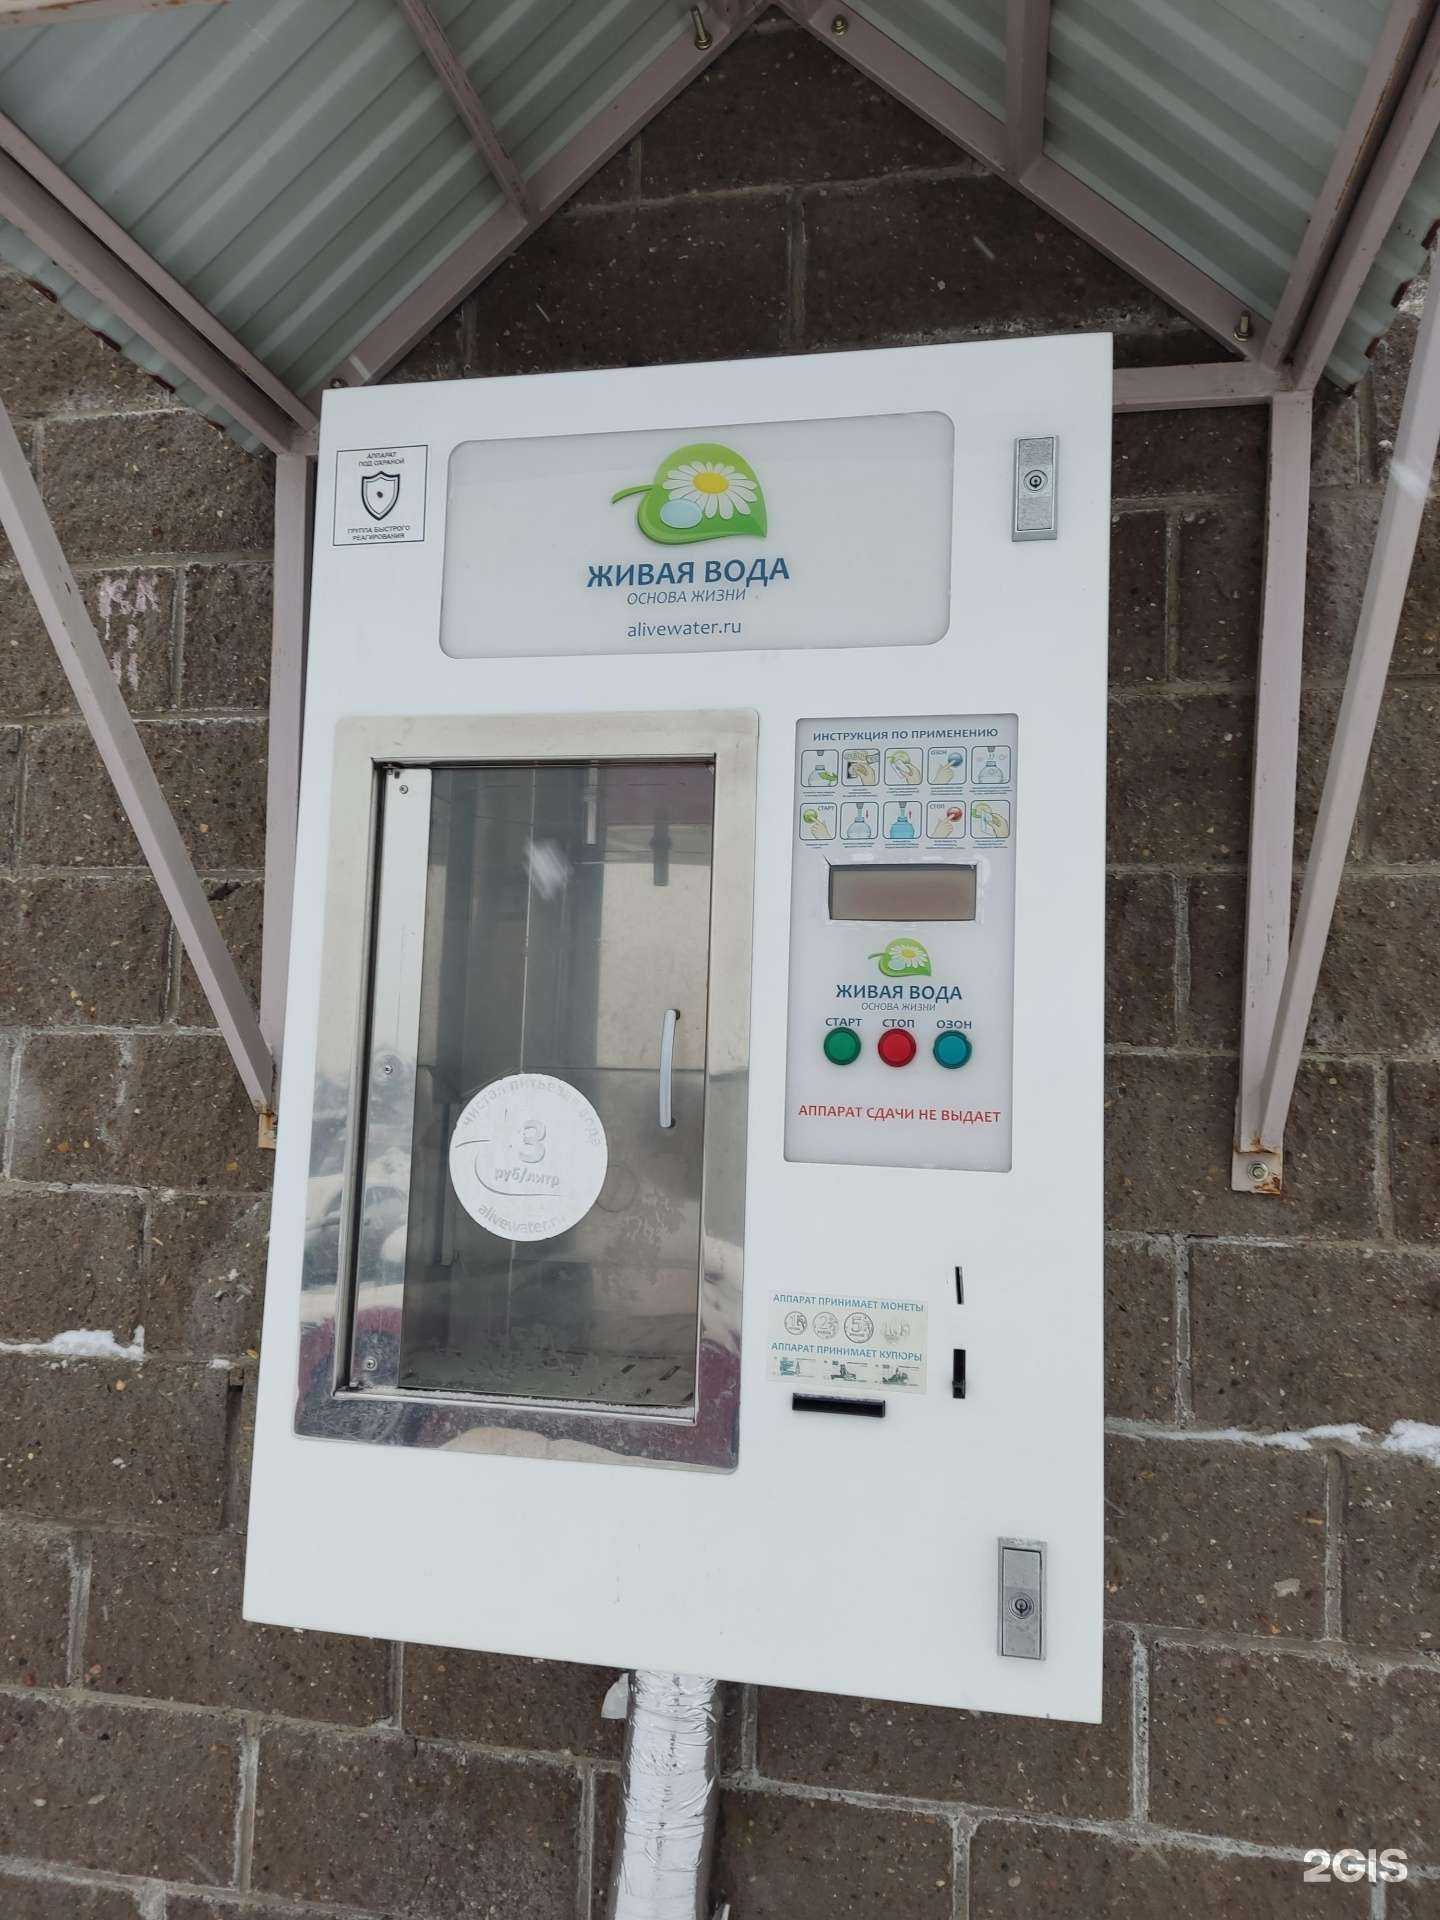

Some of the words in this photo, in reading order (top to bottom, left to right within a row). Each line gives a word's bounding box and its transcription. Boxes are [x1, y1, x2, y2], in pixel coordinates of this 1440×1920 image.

[358, 459, 373, 467] ПОД
[374, 525, 411, 533] БЫСТРОГО
[352, 533, 405, 541] РЕАГИРОВАНИЯ
[586, 560, 695, 588] ЖИВАЯ
[704, 557, 790, 587] ВОДА
[626, 591, 688, 606] ОСНОВА
[690, 588, 747, 602] ЖИЗНИ
[626, 621, 742, 638] alivewater.ru
[812, 731, 889, 742] ИНСТРУКЦИЯ
[891, 730, 909, 740] ПО
[911, 728, 998, 739] ПРИМЕНЕНИЮ
[836, 984, 903, 999] ЖИВАЯ
[909, 985, 963, 1003] ВОДА
[861, 1002, 899, 1011] ОСНОВА
[901, 1003, 936, 1012] ЖИЗНИ
[825, 1017, 863, 1027] СТАРТ
[882, 1018, 915, 1028] СТОП
[936, 1020, 972, 1030] ОЗОН
[798, 1104, 863, 1118] АППАРАТ
[866, 1106, 915, 1122] СДАЧИ
[919, 1109, 937, 1121] НЕ
[941, 1110, 1001, 1124] ВЫДАЕТ
[494, 1166, 561, 1189] руб/литр
[773, 1294, 816, 1305] АППАРАТ
[818, 1297, 878, 1310] ПРИНИМАЕТ
[880, 1301, 924, 1313] МОНЕТЫ
[771, 1342, 815, 1354] АППАРАТ
[816, 1345, 878, 1359] ПРИНИМАЕТ
[879, 1350, 923, 1362] КУПЮРЫ
